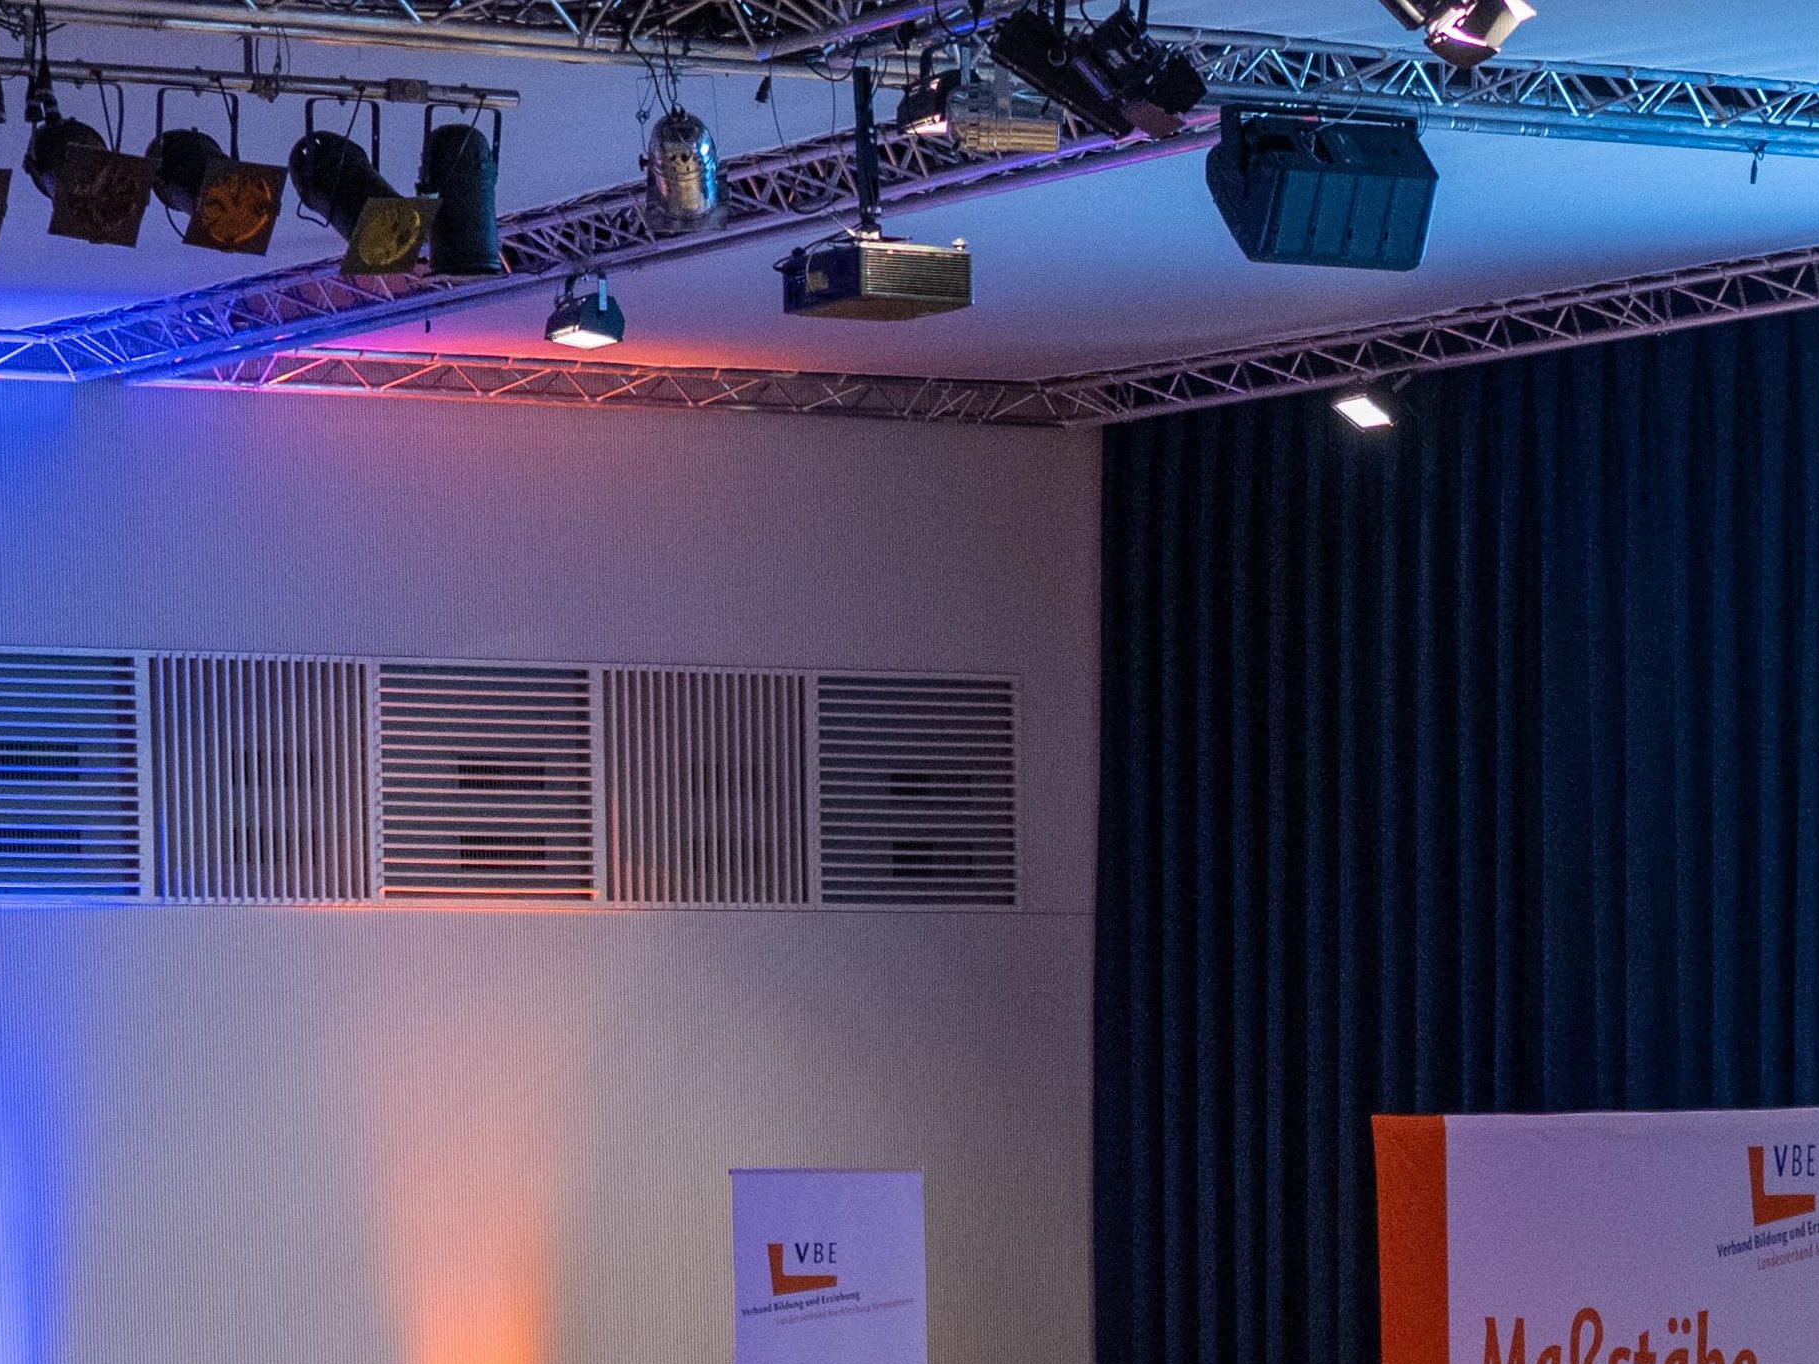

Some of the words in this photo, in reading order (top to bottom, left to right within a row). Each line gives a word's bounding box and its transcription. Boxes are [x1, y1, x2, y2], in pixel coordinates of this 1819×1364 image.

[1773, 1144, 1816, 1178] VBE
[795, 1242, 838, 1264] VBE
[1716, 1236, 1753, 1258] Verband
[1754, 1230, 1788, 1249] Bildung
[1789, 1223, 1806, 1241] und
